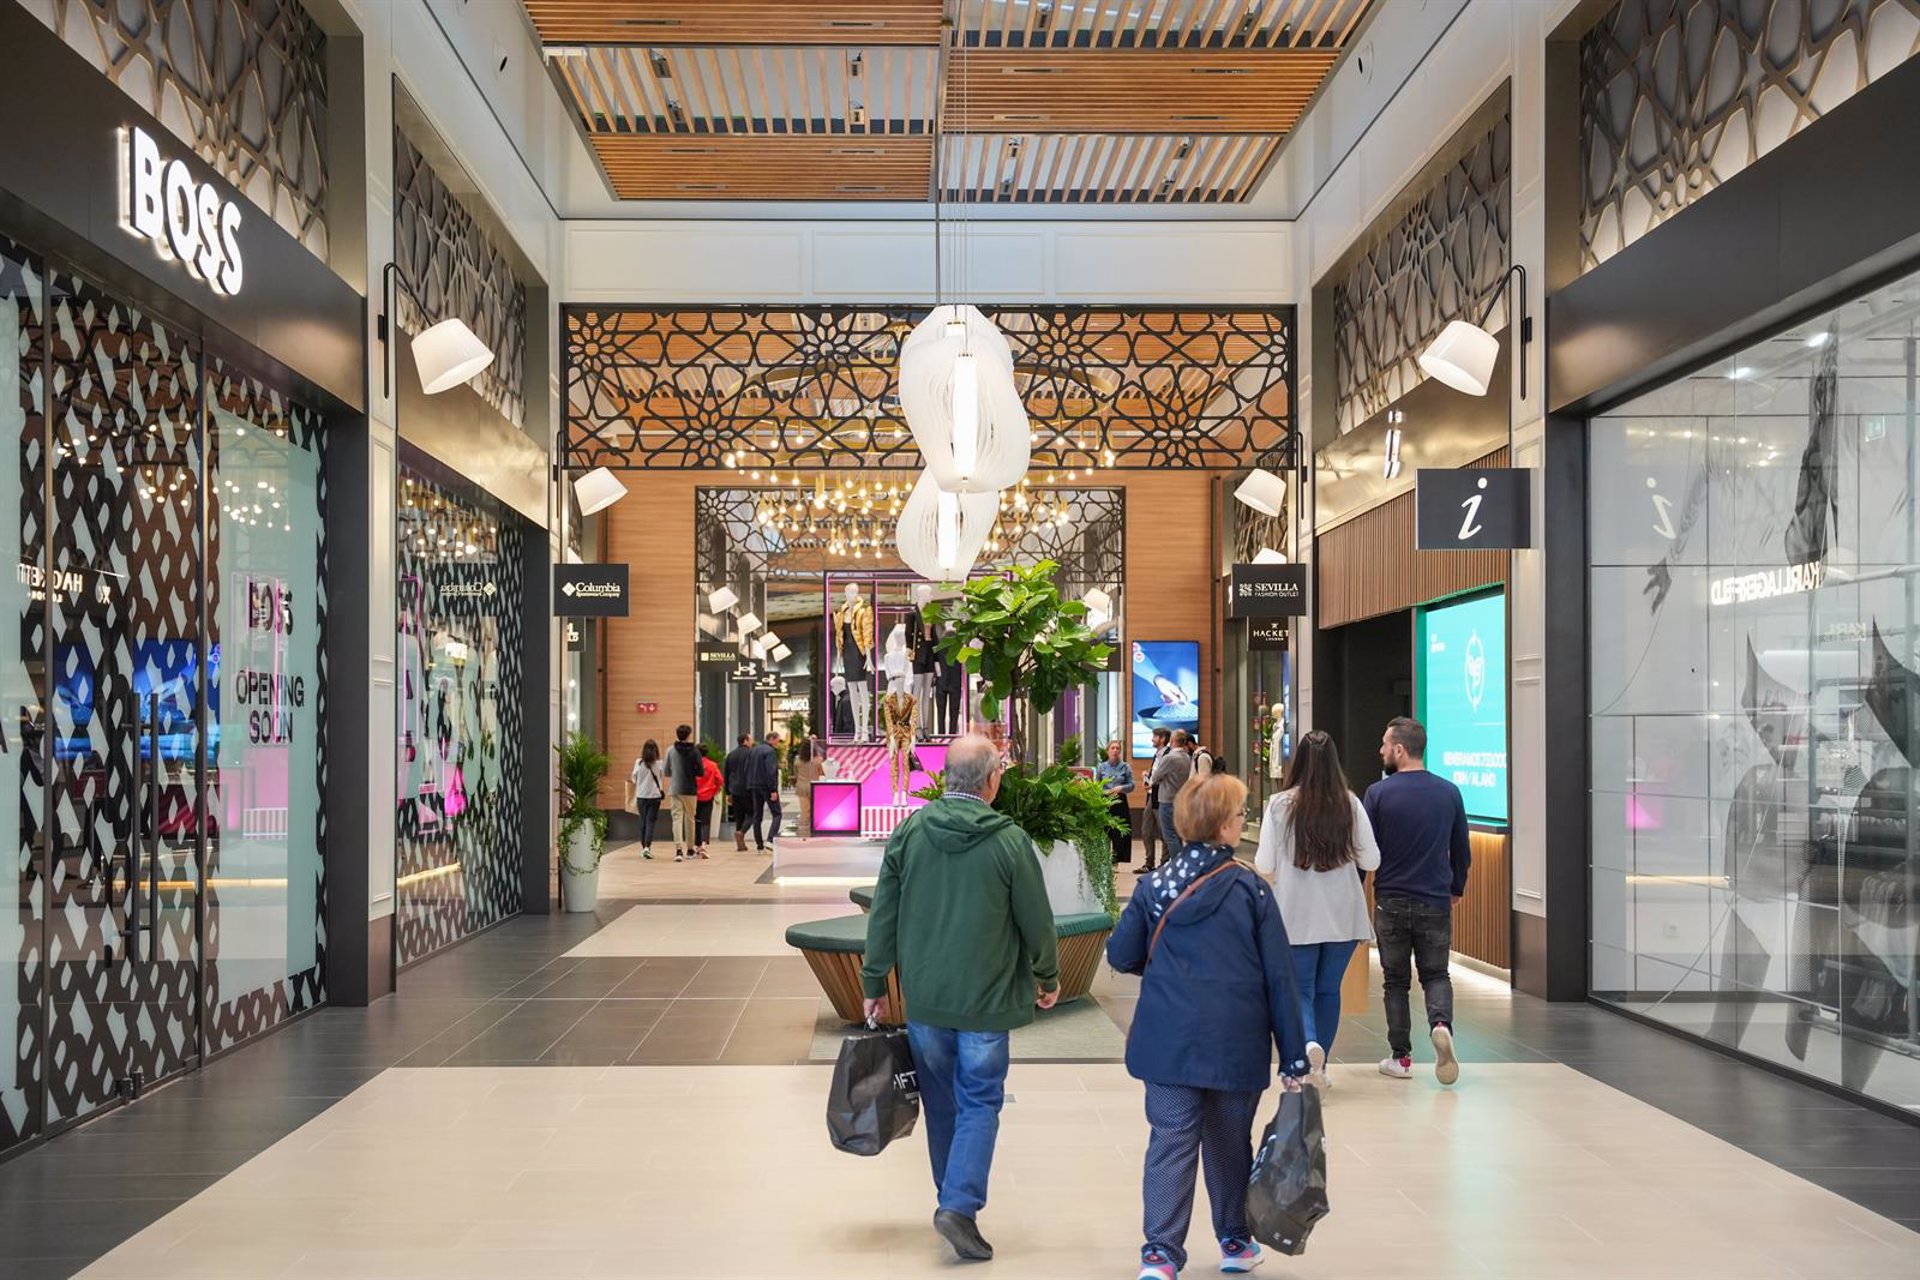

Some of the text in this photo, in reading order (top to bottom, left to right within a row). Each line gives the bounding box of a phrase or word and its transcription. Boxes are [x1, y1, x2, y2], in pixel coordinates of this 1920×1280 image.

[130, 126, 243, 296] BOSS
[1457, 477, 1488, 540] i
[575, 582, 621, 593] Columbia
[1254, 582, 1299, 591] SEVILLA
[236, 670, 305, 707] OPENING
[250, 710, 293, 744] SOON
